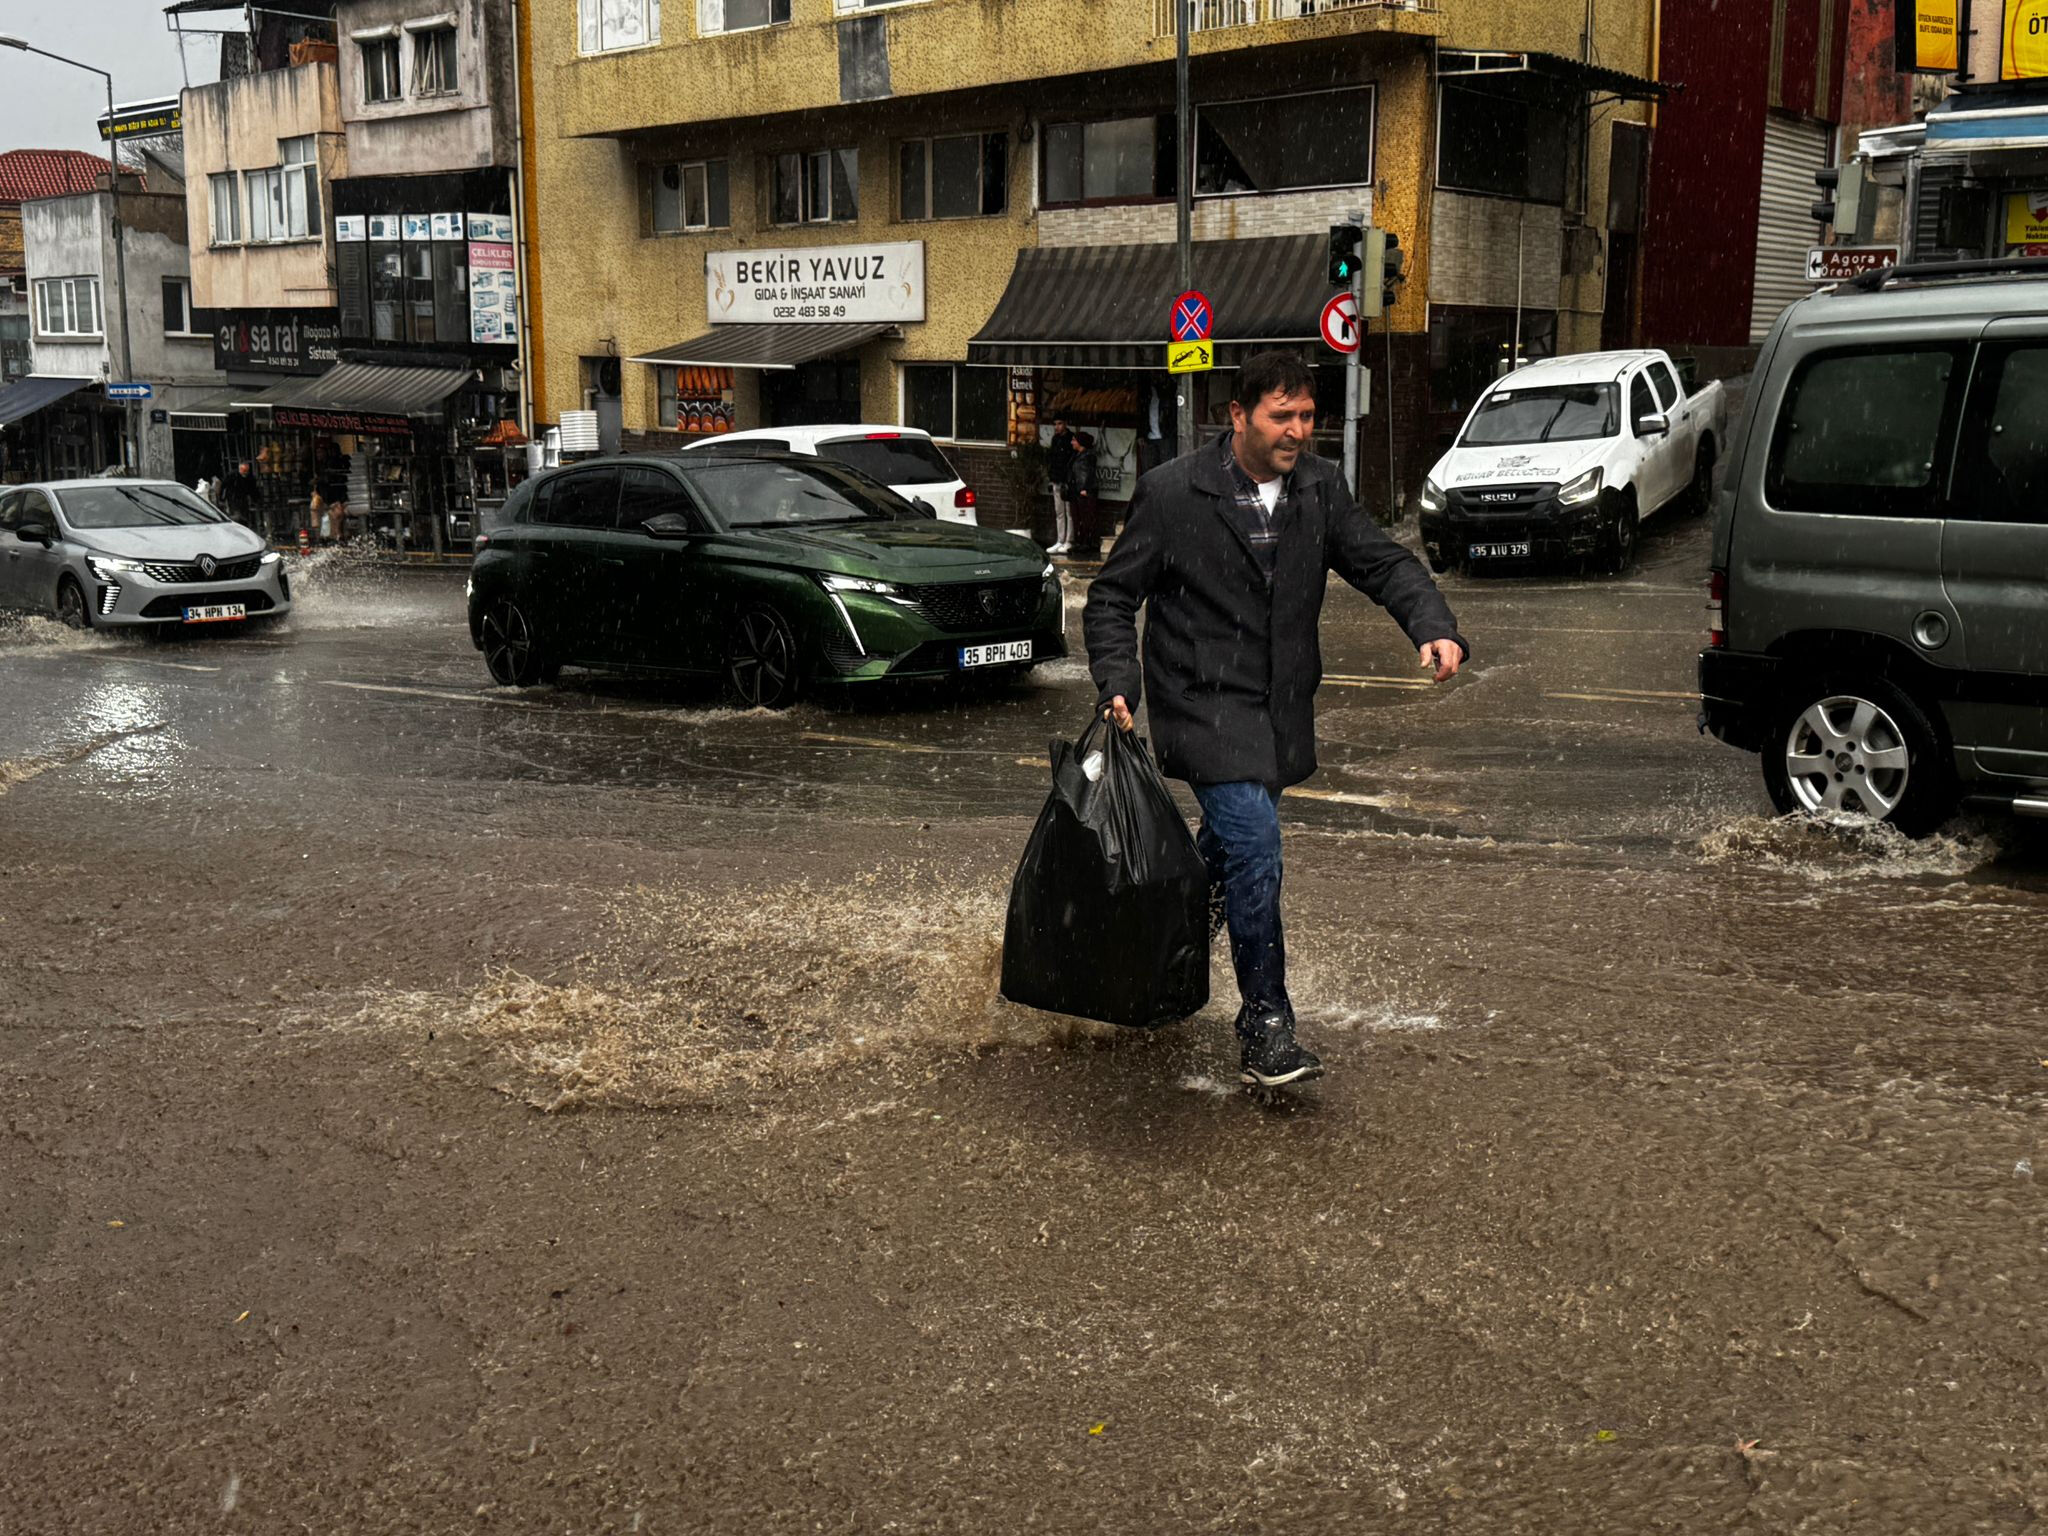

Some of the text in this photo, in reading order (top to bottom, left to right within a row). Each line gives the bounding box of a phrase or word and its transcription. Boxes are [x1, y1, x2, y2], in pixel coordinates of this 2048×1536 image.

[1830, 253, 1876, 267] Agora
[736, 254, 885, 283] BEKİR YAVUZ
[1821, 263, 1852, 276] Ören
[754, 282, 866, 303] GIDA & İNŞAAT SANAYİ
[773, 305, 846, 318] 0232 483 58 49
[1480, 493, 1517, 502] ISUZU
[1475, 544, 1528, 556] 35 AIU 379
[189, 608, 201, 619] 34
[227, 605, 243, 616] 134
[965, 642, 1030, 665] 35 BPH 403
